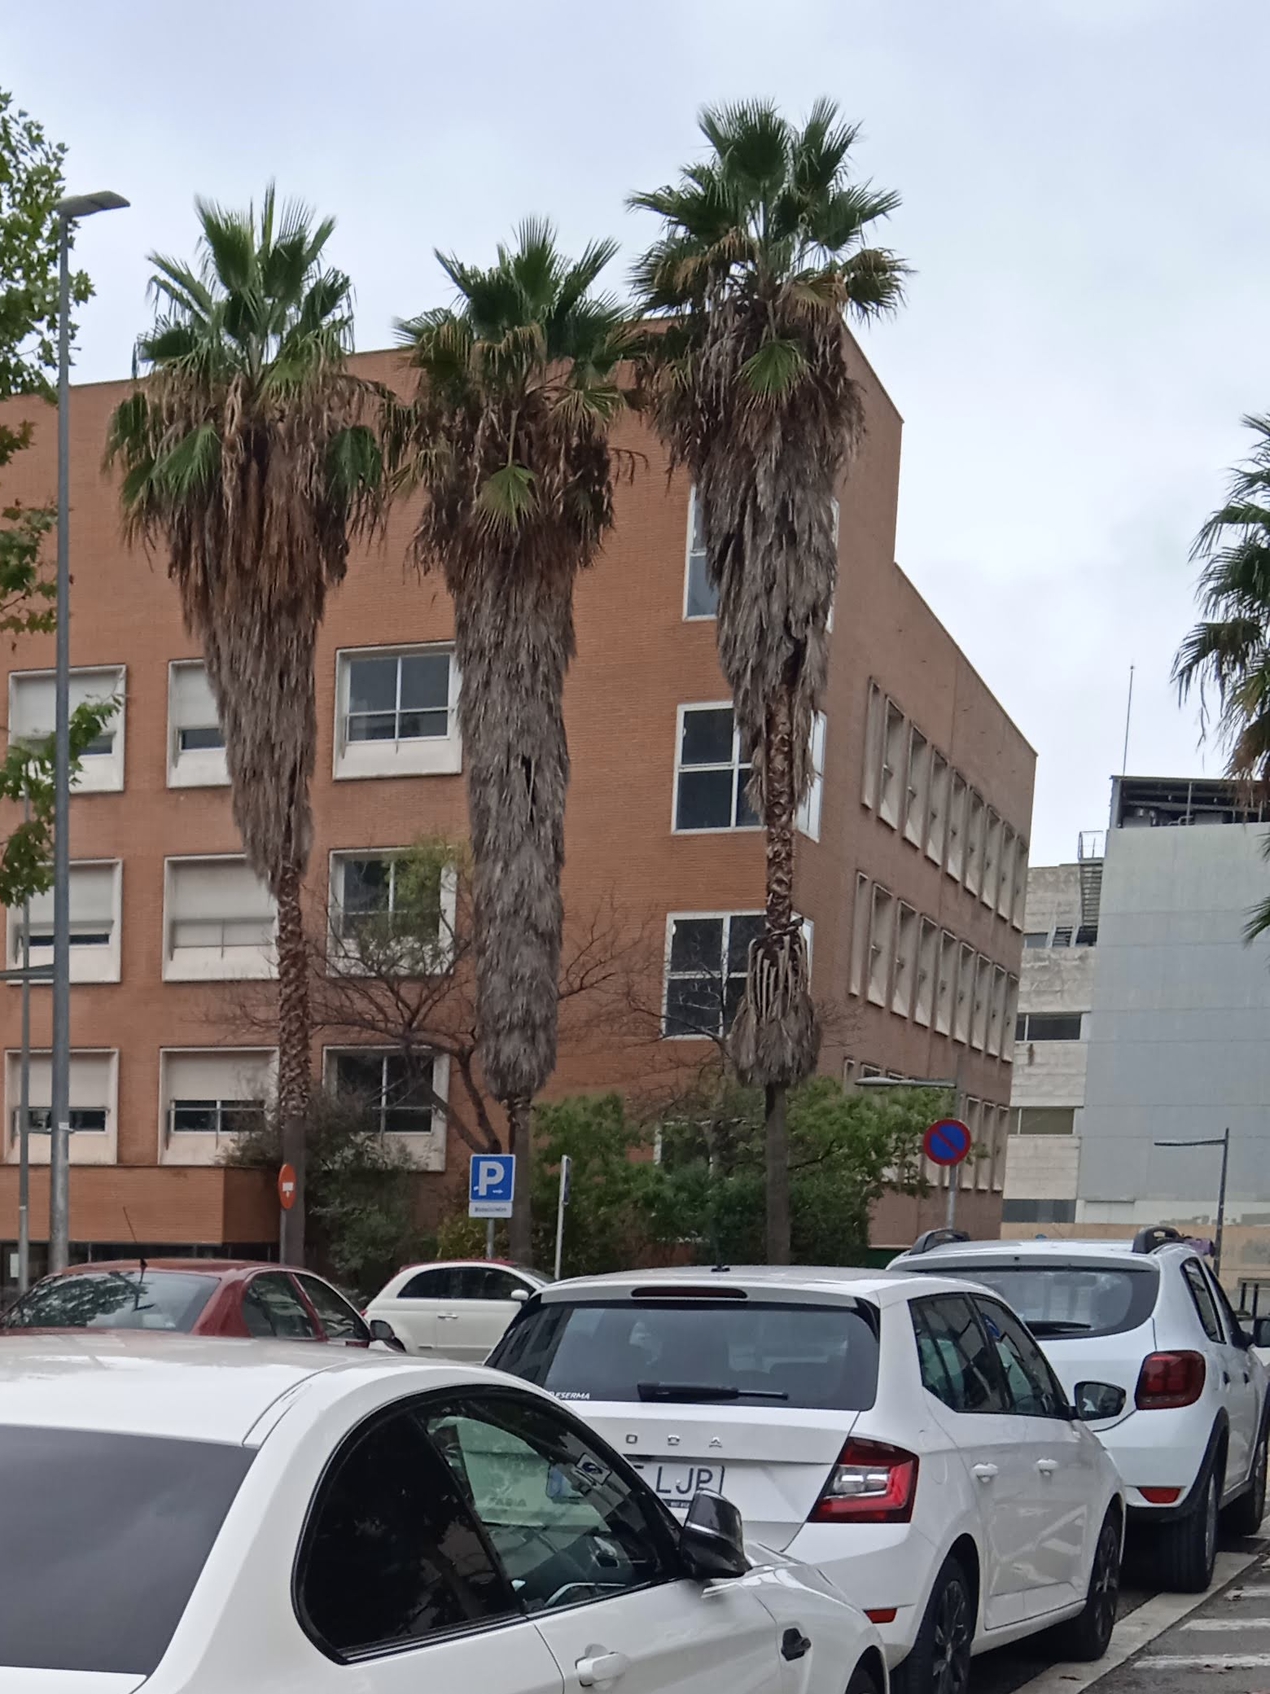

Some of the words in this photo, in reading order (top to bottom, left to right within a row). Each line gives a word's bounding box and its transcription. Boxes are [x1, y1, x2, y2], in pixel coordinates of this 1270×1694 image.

[478, 1161, 505, 1196] P
[625, 1434, 723, 1449] ODA
[656, 1466, 713, 1494] LJP
